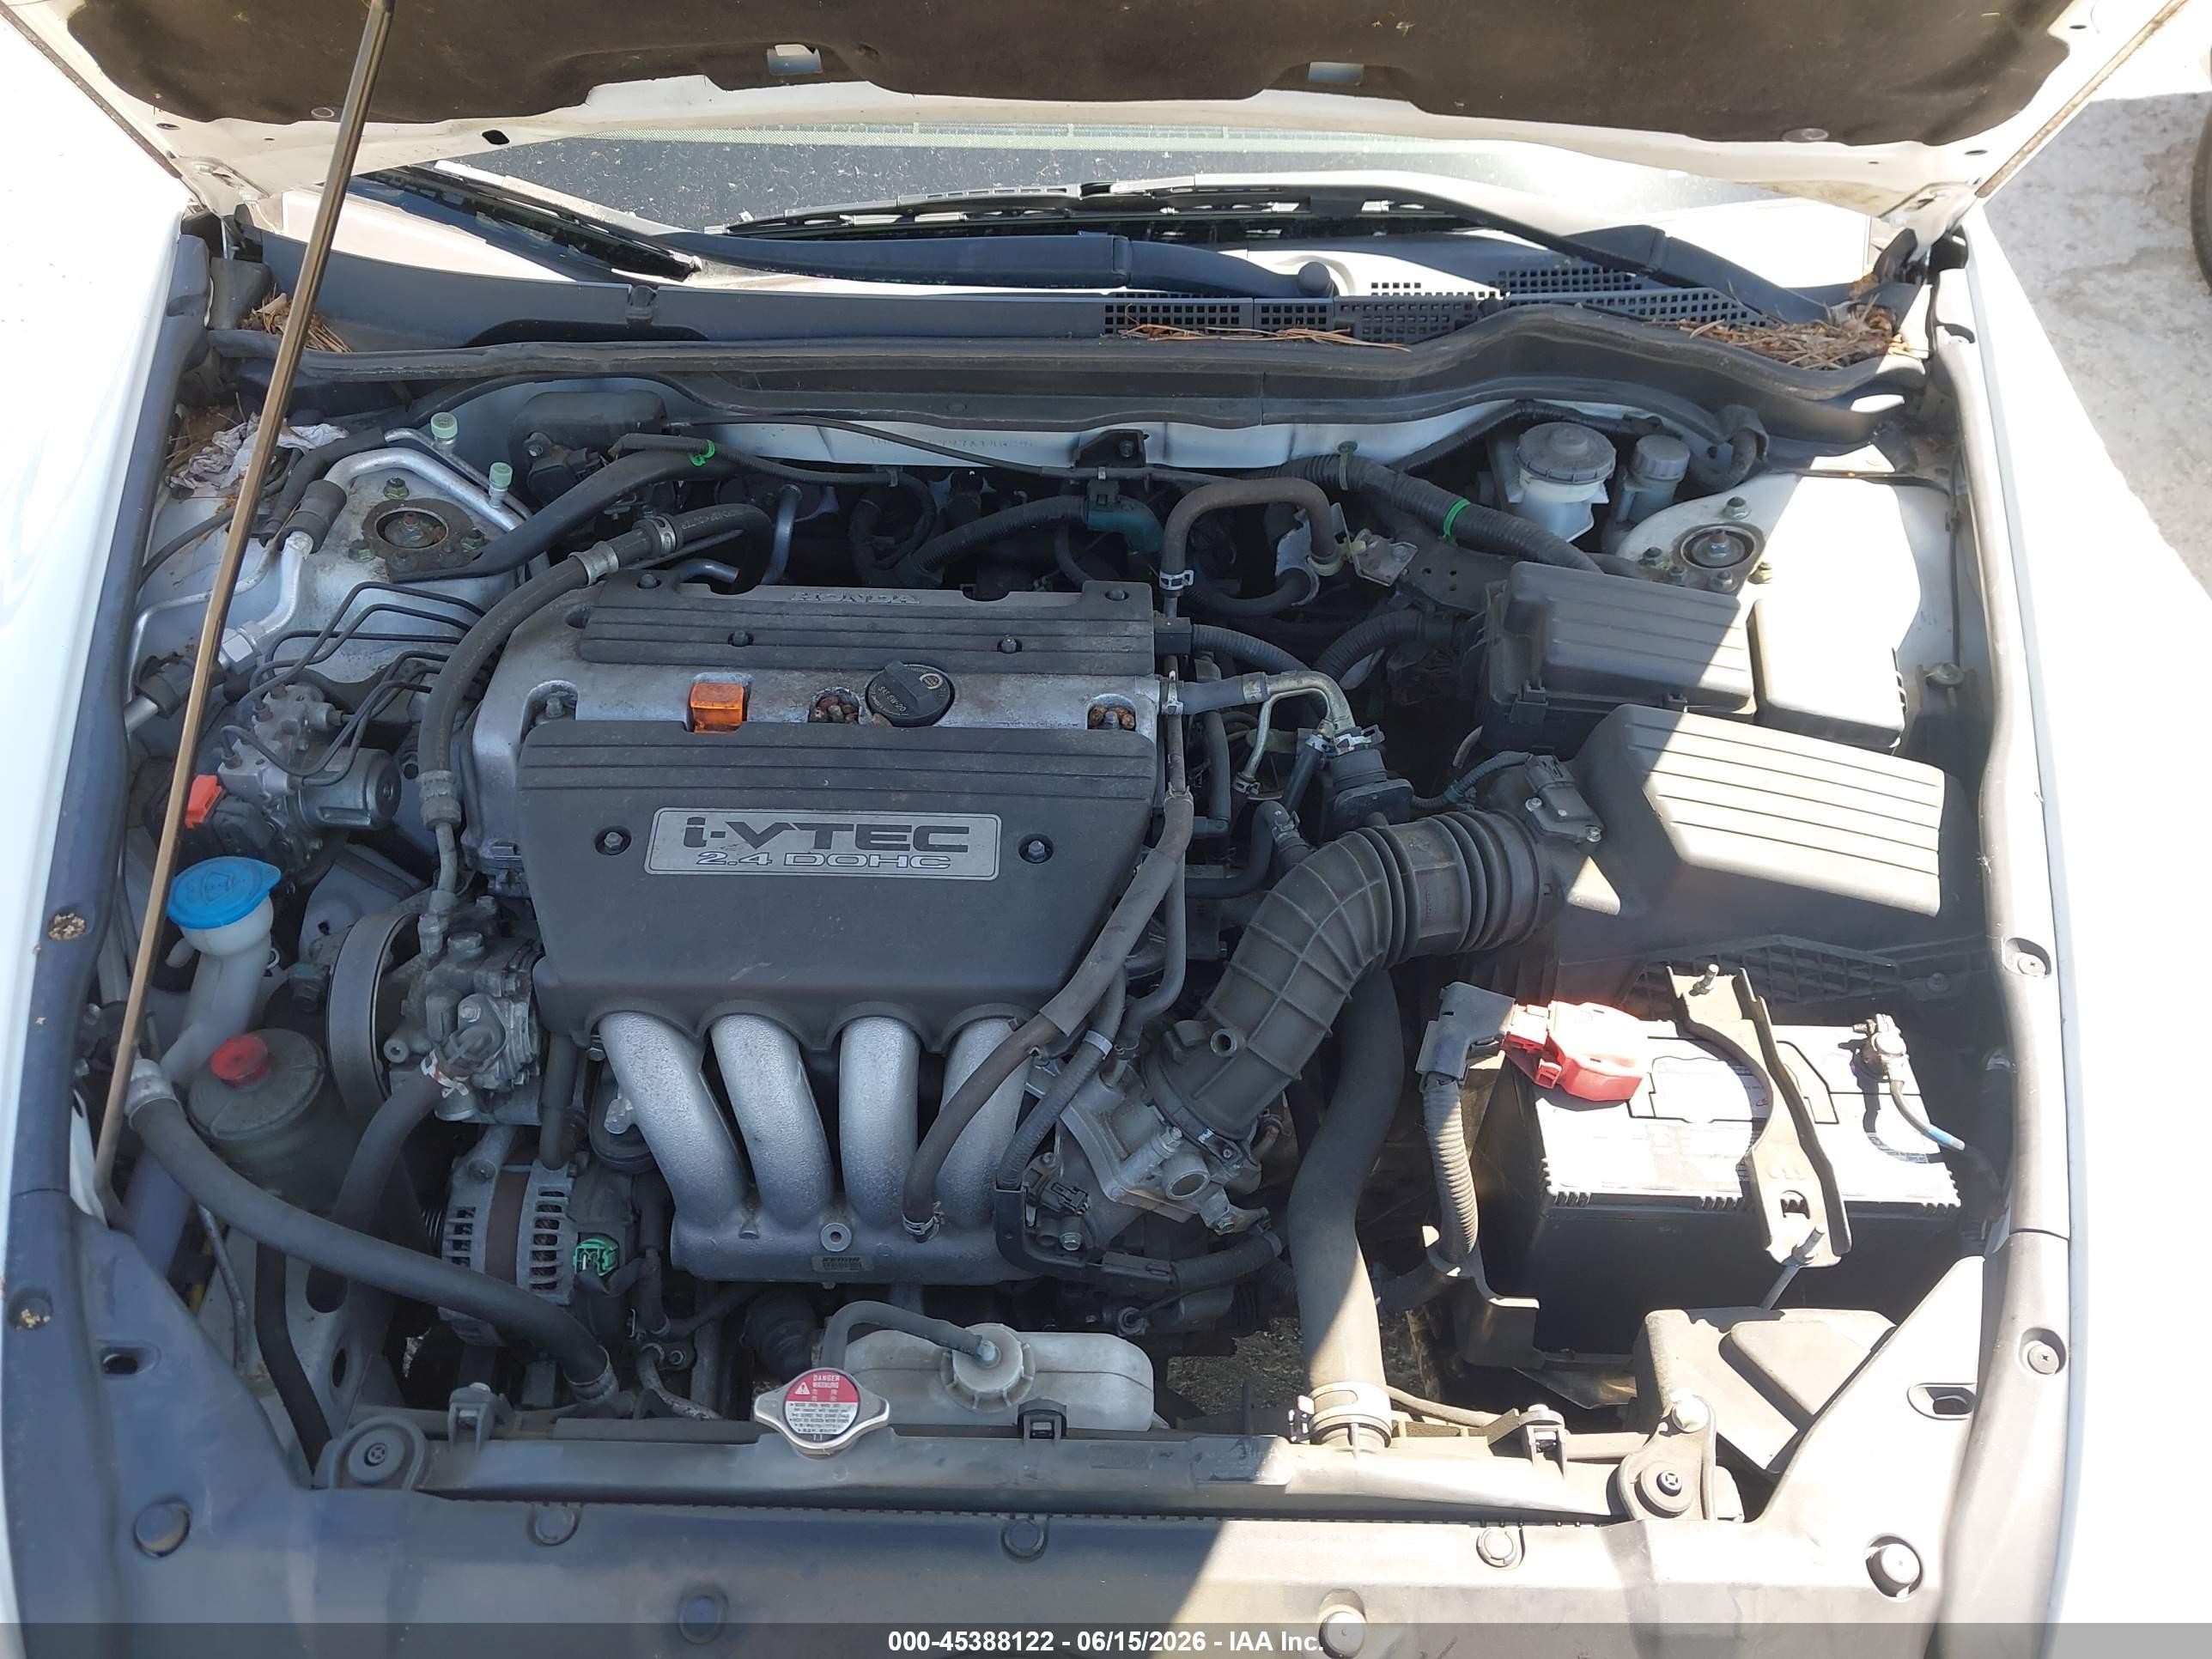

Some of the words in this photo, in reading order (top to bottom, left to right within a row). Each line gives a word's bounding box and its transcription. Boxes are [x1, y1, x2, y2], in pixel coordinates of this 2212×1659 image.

[684, 817, 969, 853] i-VTEC
[696, 851, 772, 866] 2.4
[784, 852, 951, 869] DOHC
